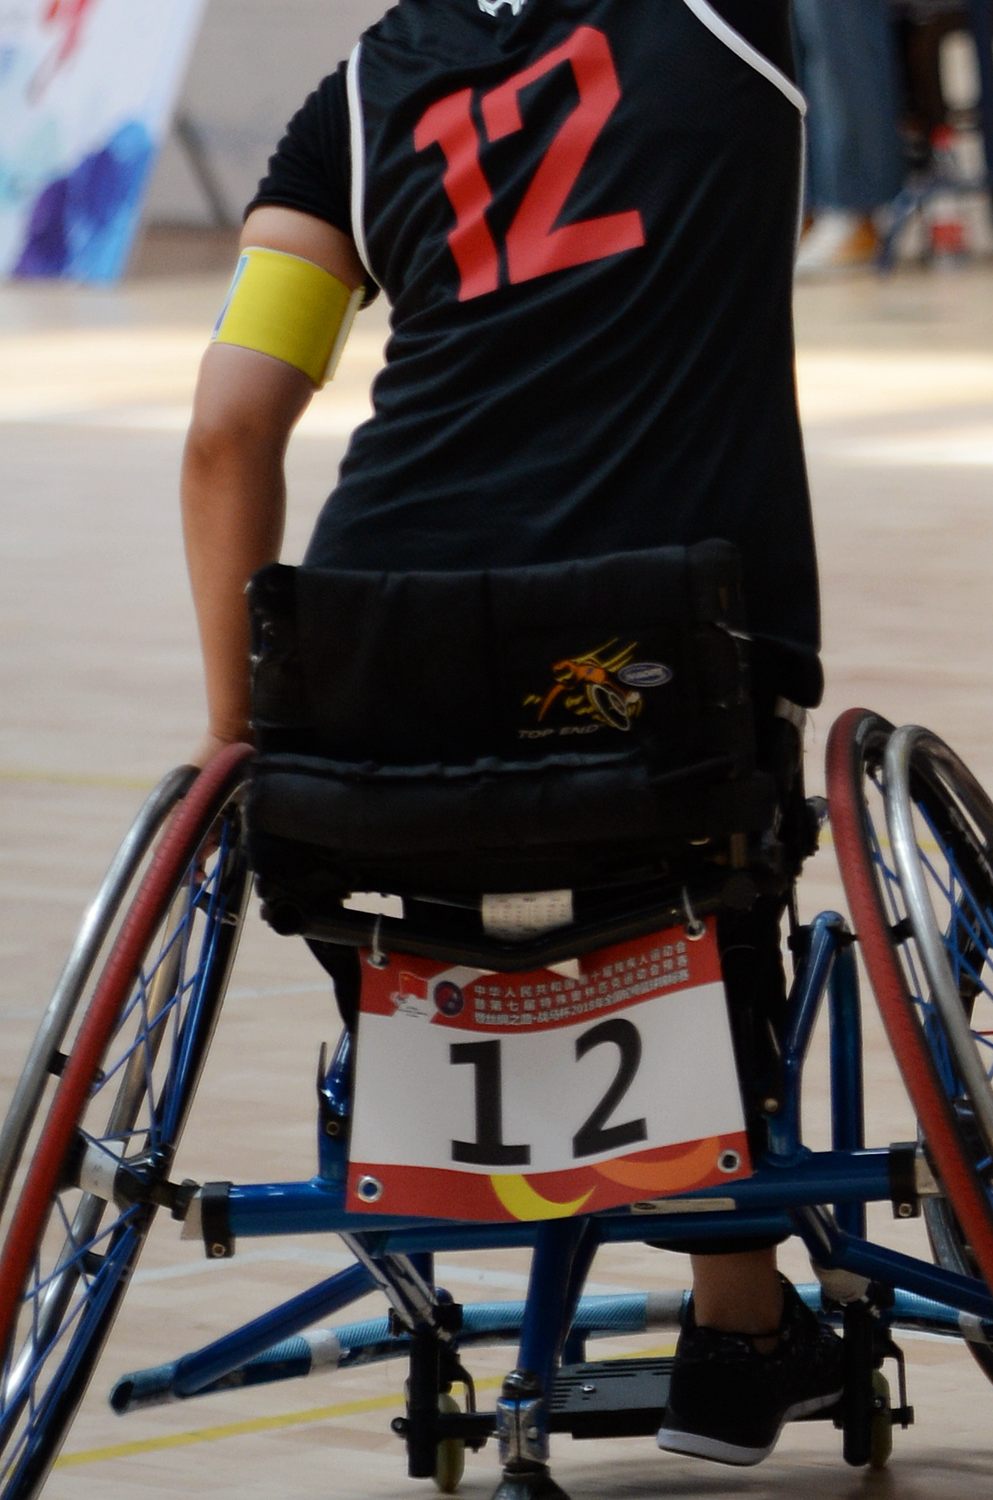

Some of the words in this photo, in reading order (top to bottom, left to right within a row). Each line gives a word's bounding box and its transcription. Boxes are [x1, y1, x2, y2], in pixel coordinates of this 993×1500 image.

[413, 24, 647, 302] 12
[518, 728, 554, 739] TOP
[559, 724, 599, 736] END
[449, 1017, 649, 1167] 12
